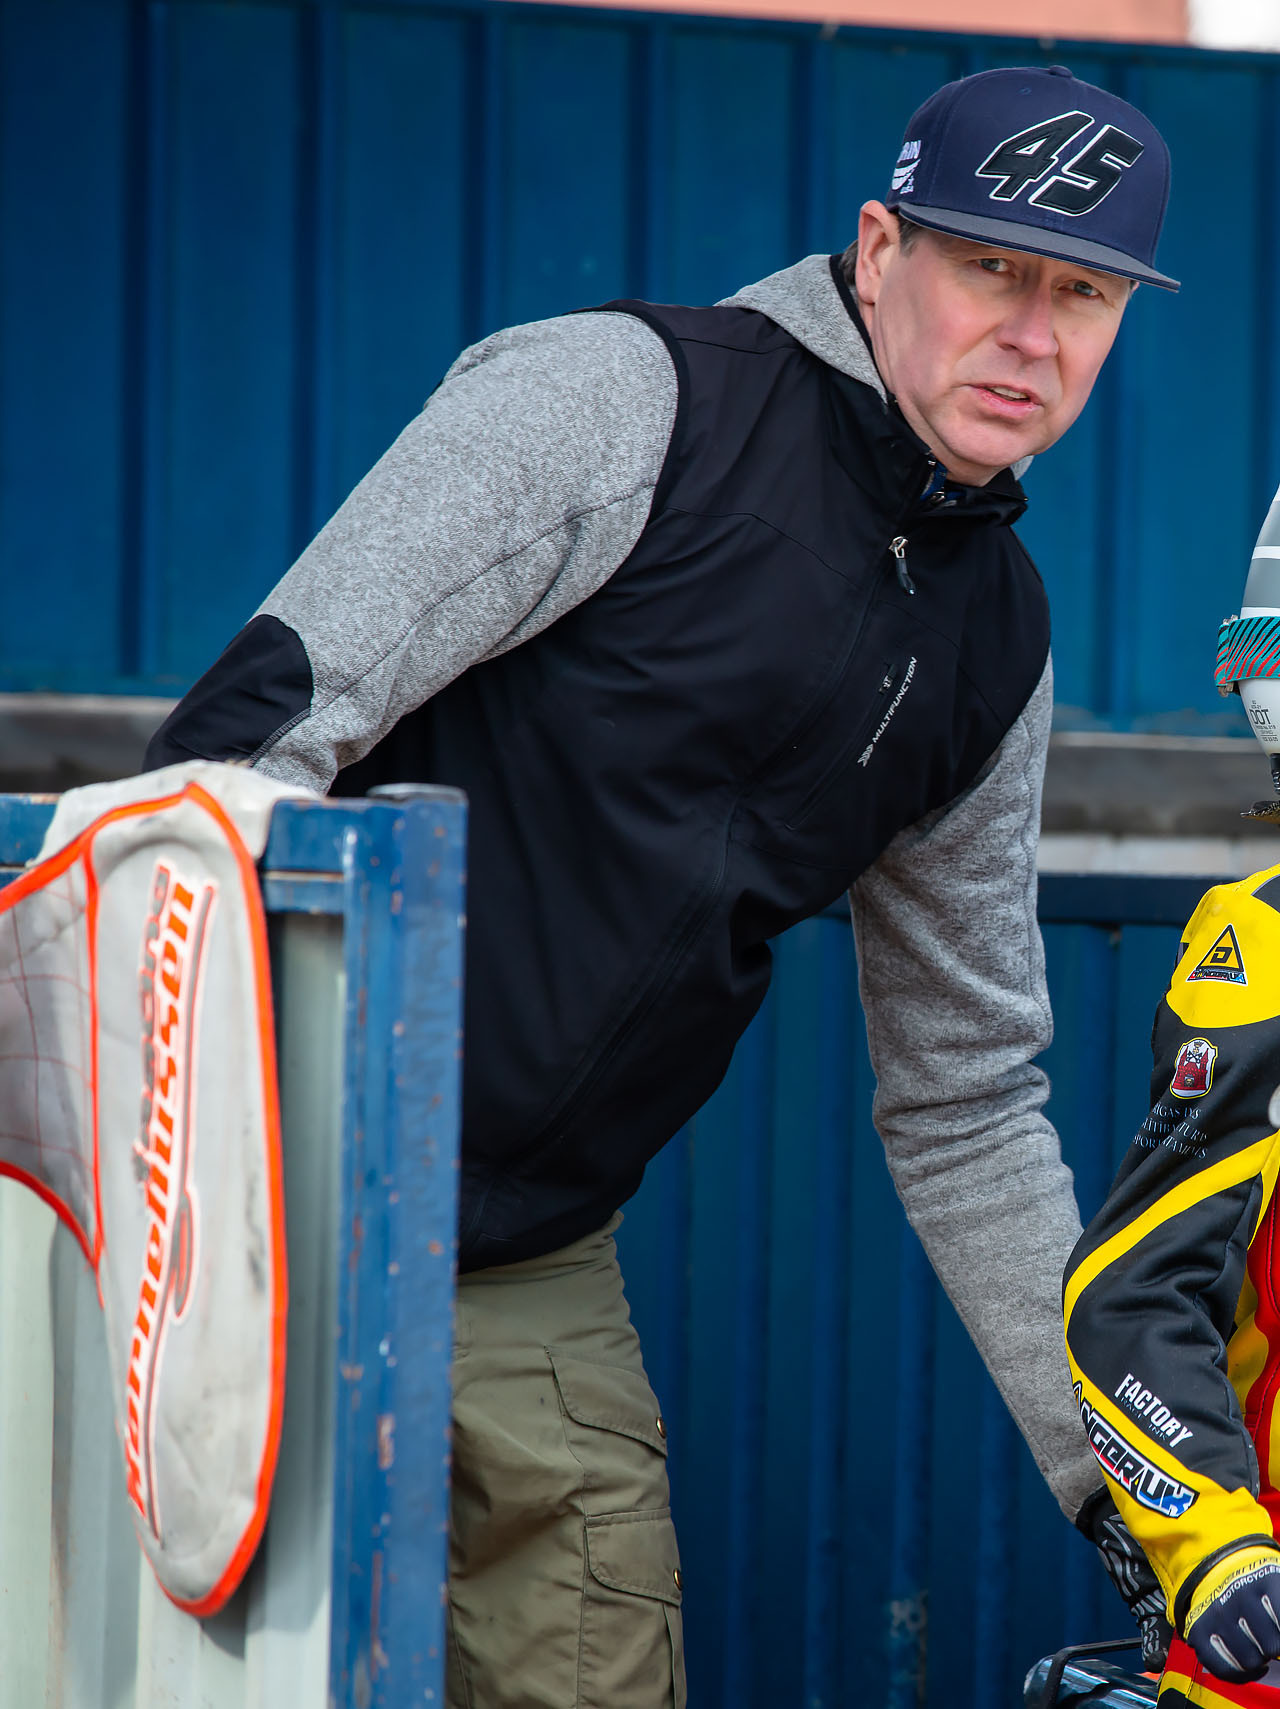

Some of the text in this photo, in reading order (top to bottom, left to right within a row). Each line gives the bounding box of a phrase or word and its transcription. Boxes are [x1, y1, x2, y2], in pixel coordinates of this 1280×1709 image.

[976, 110, 1144, 216] 45
[872, 656, 918, 743] MULTIFUNCTION
[1250, 708, 1271, 726] DOT
[1210, 946, 1233, 964] D
[1114, 1372, 1194, 1448] FACTORY
